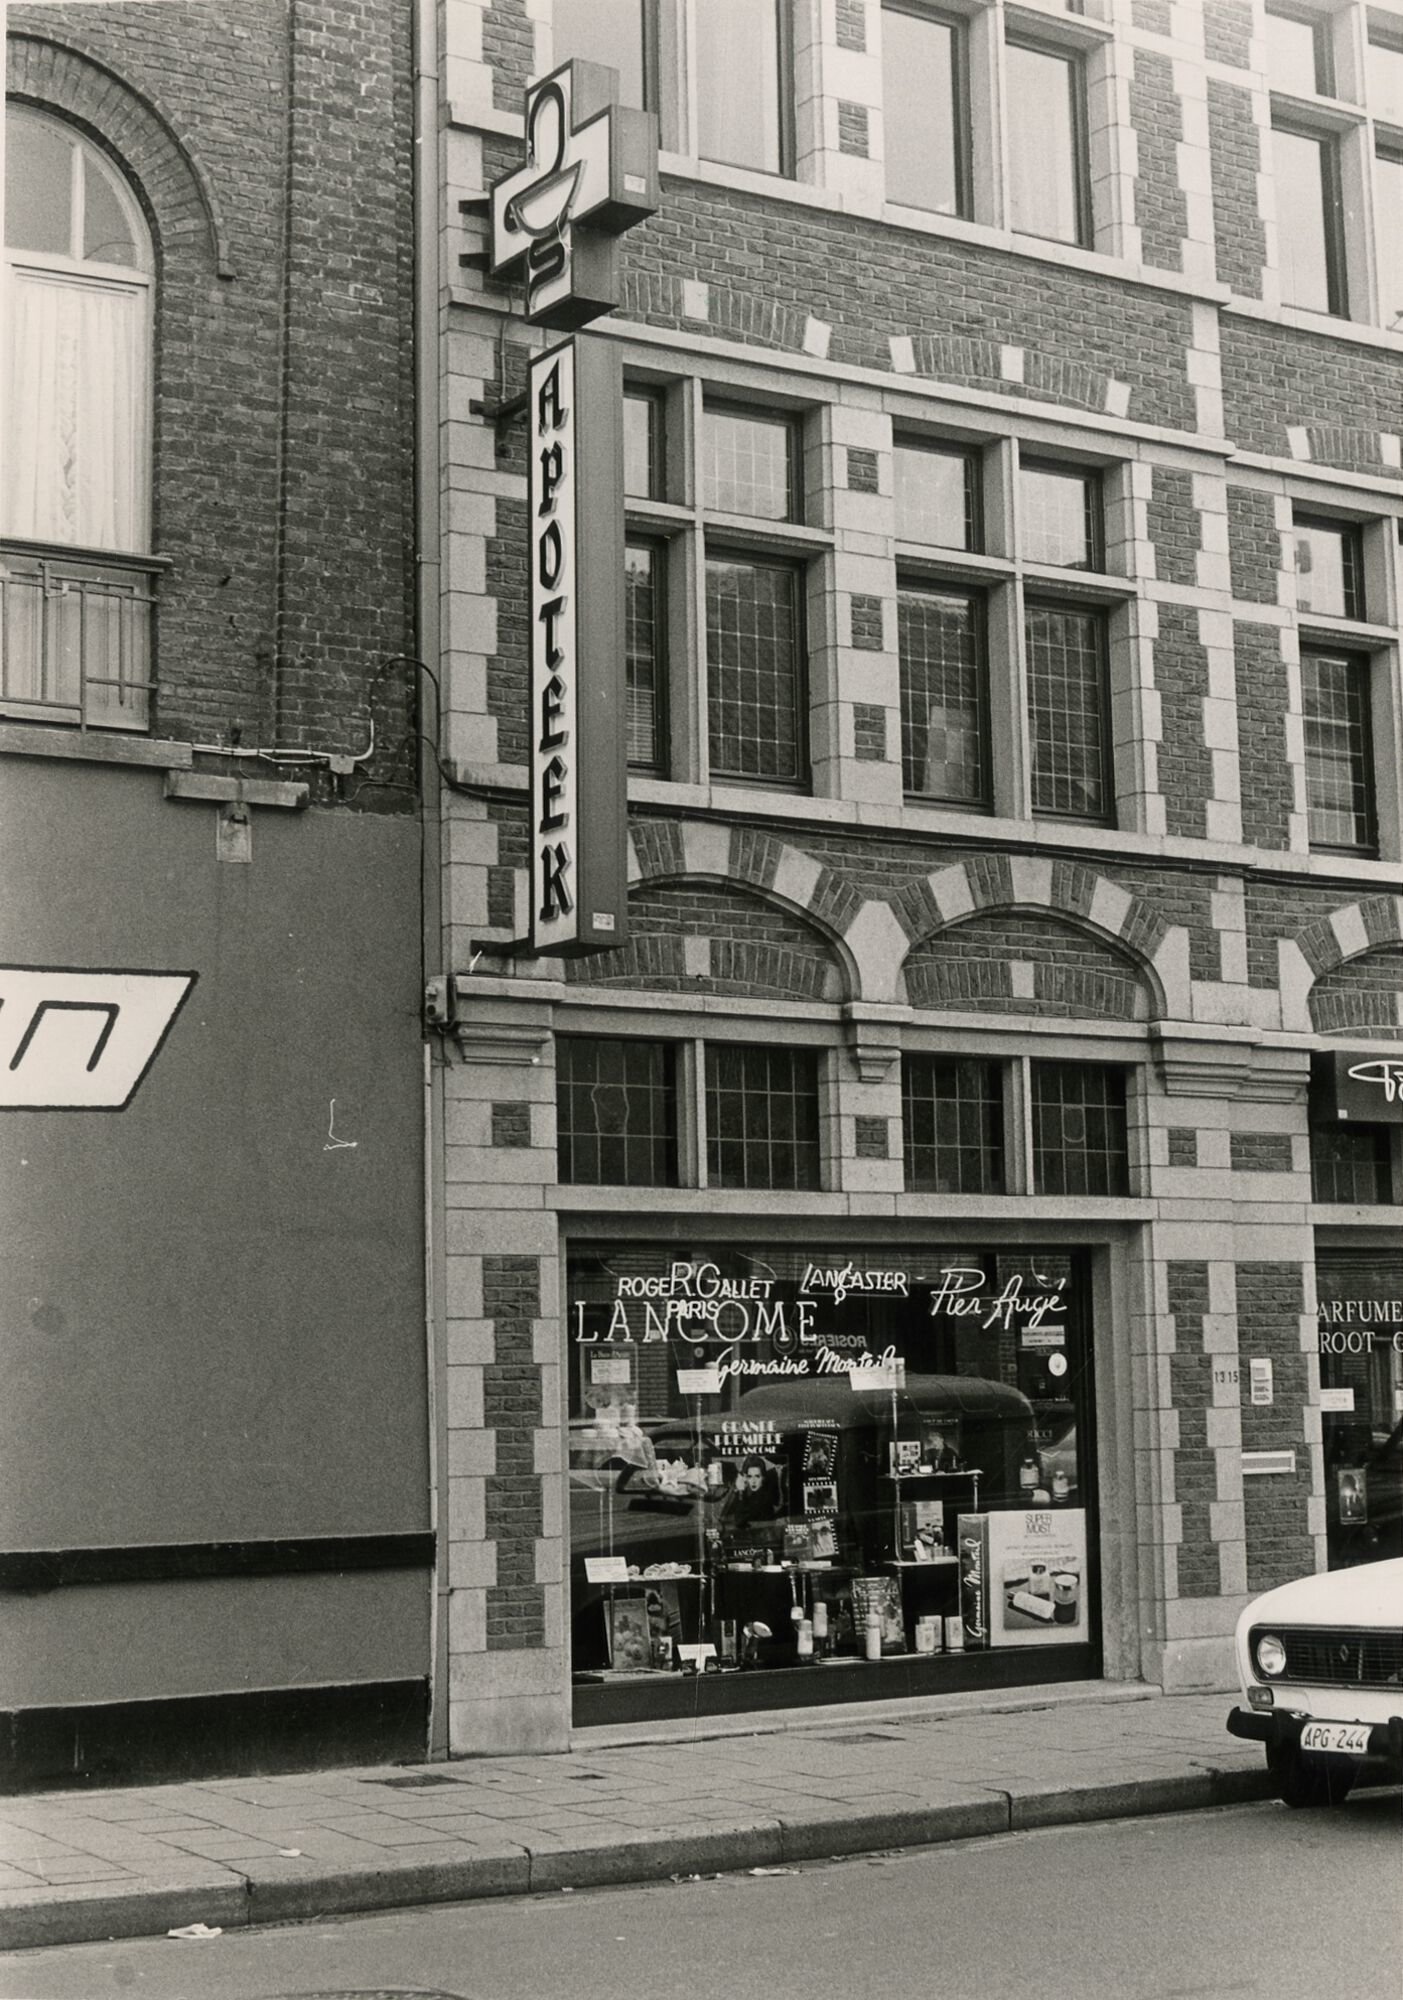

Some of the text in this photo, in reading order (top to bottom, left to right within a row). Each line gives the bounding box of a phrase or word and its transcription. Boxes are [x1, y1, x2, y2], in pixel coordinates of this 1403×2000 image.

[537, 357, 574, 923] APOTEEK
[0, 1000, 120, 1072] n
[800, 1261, 909, 1306] LANCASTER
[575, 1299, 818, 1343] LANCOME
[667, 1299, 720, 1320] PARIS
[715, 1345, 810, 1390] Germaine
[721, 1420, 777, 1434] GRANDE
